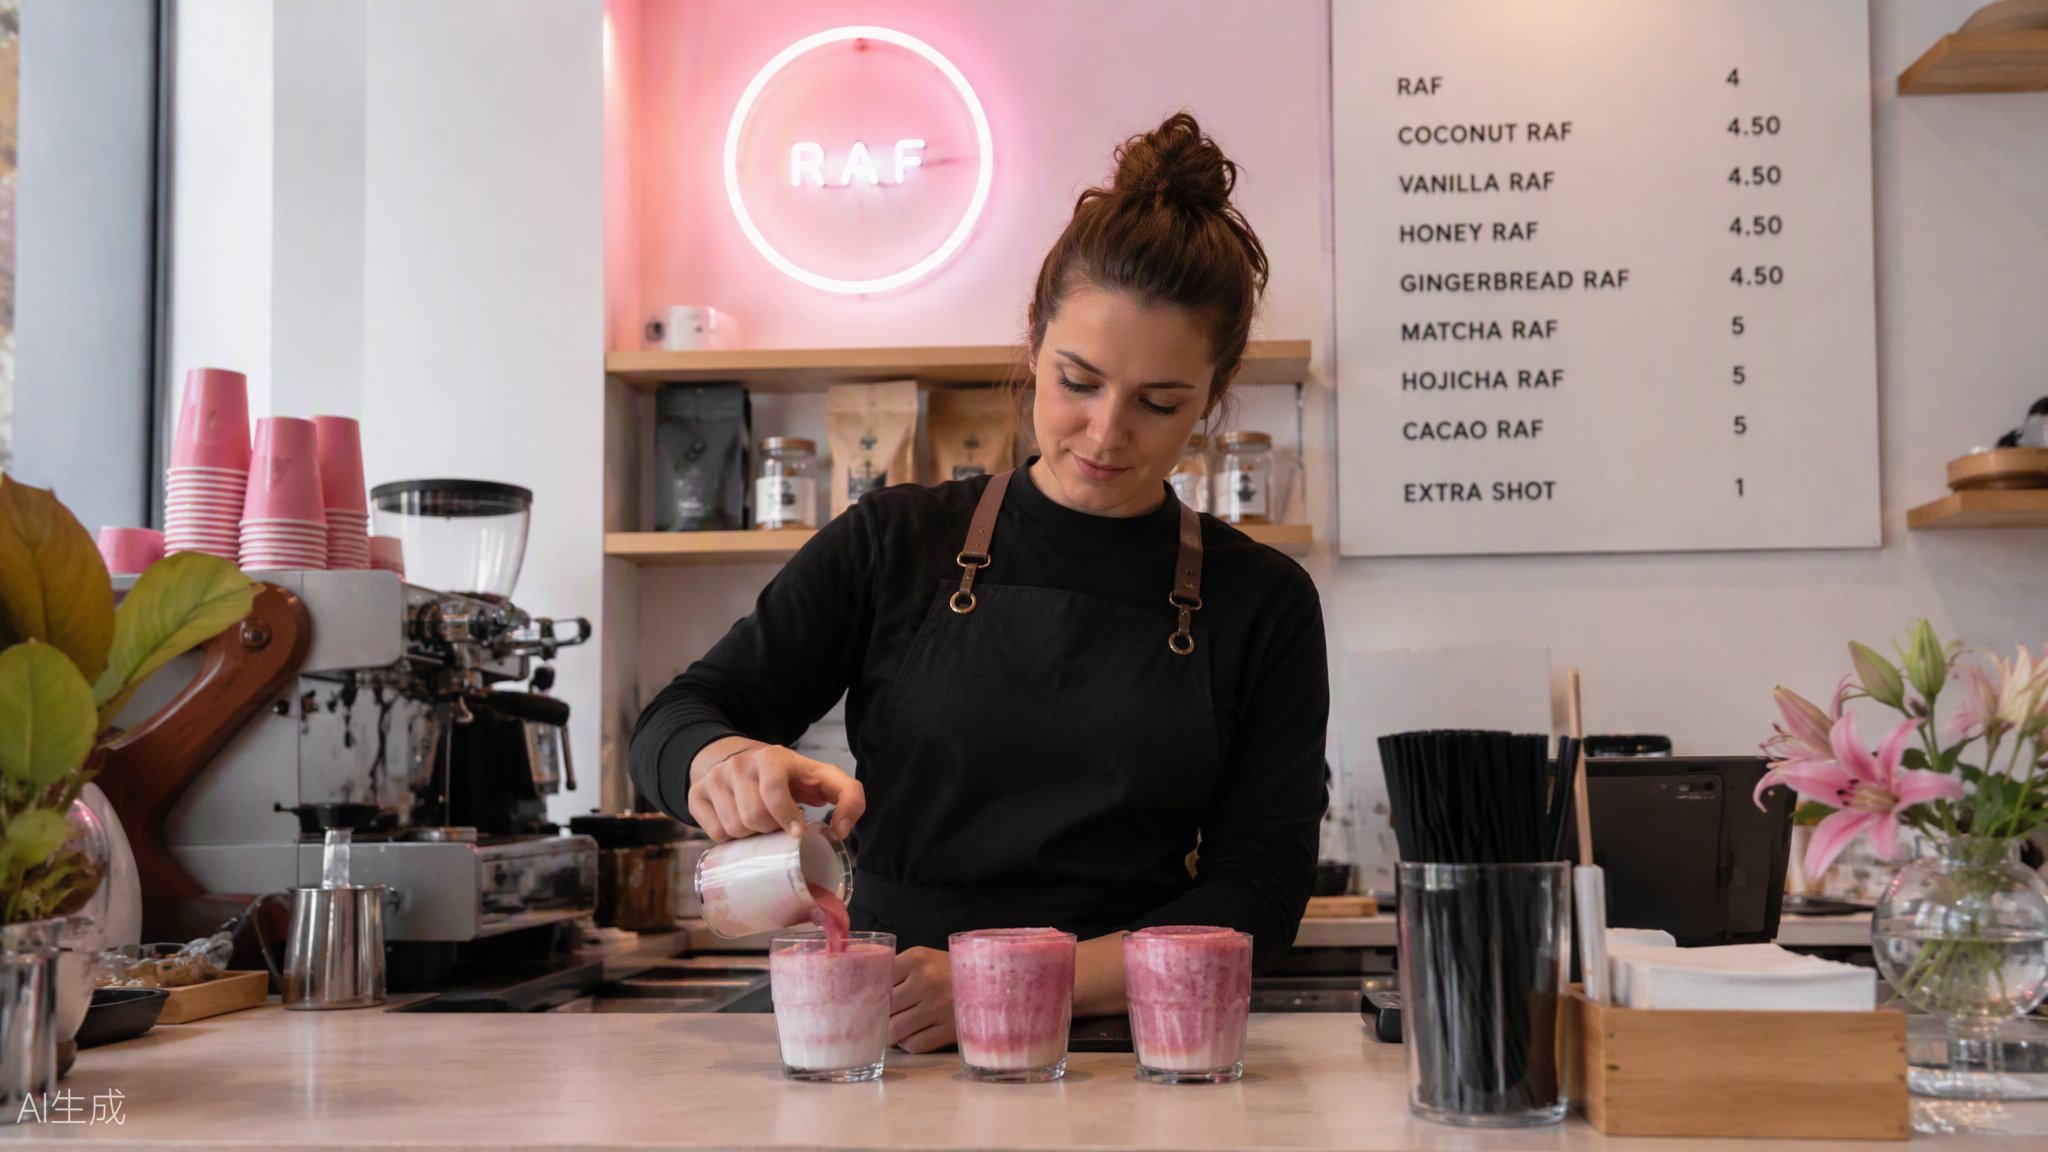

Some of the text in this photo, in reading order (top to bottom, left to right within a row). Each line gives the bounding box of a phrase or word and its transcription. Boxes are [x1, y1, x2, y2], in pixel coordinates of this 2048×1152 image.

[1396, 67, 1740, 96] RAF 4
[1397, 114, 1782, 146] COCONUT RAF 4.50
[790, 138, 927, 188] RAF
[1398, 164, 1782, 195] VANILLA RAF 4.50
[1399, 214, 1783, 244] HONEY RAF 4.50
[1399, 265, 1784, 294] GINGERBREAD RAF 4.50
[1400, 315, 1745, 342] MATCHA RAF 5
[1401, 365, 1746, 391] HOJICHA RAF 5
[1402, 415, 1748, 442] CACAO RAF 5
[1403, 477, 1745, 504] EXTRA SHOT 1
